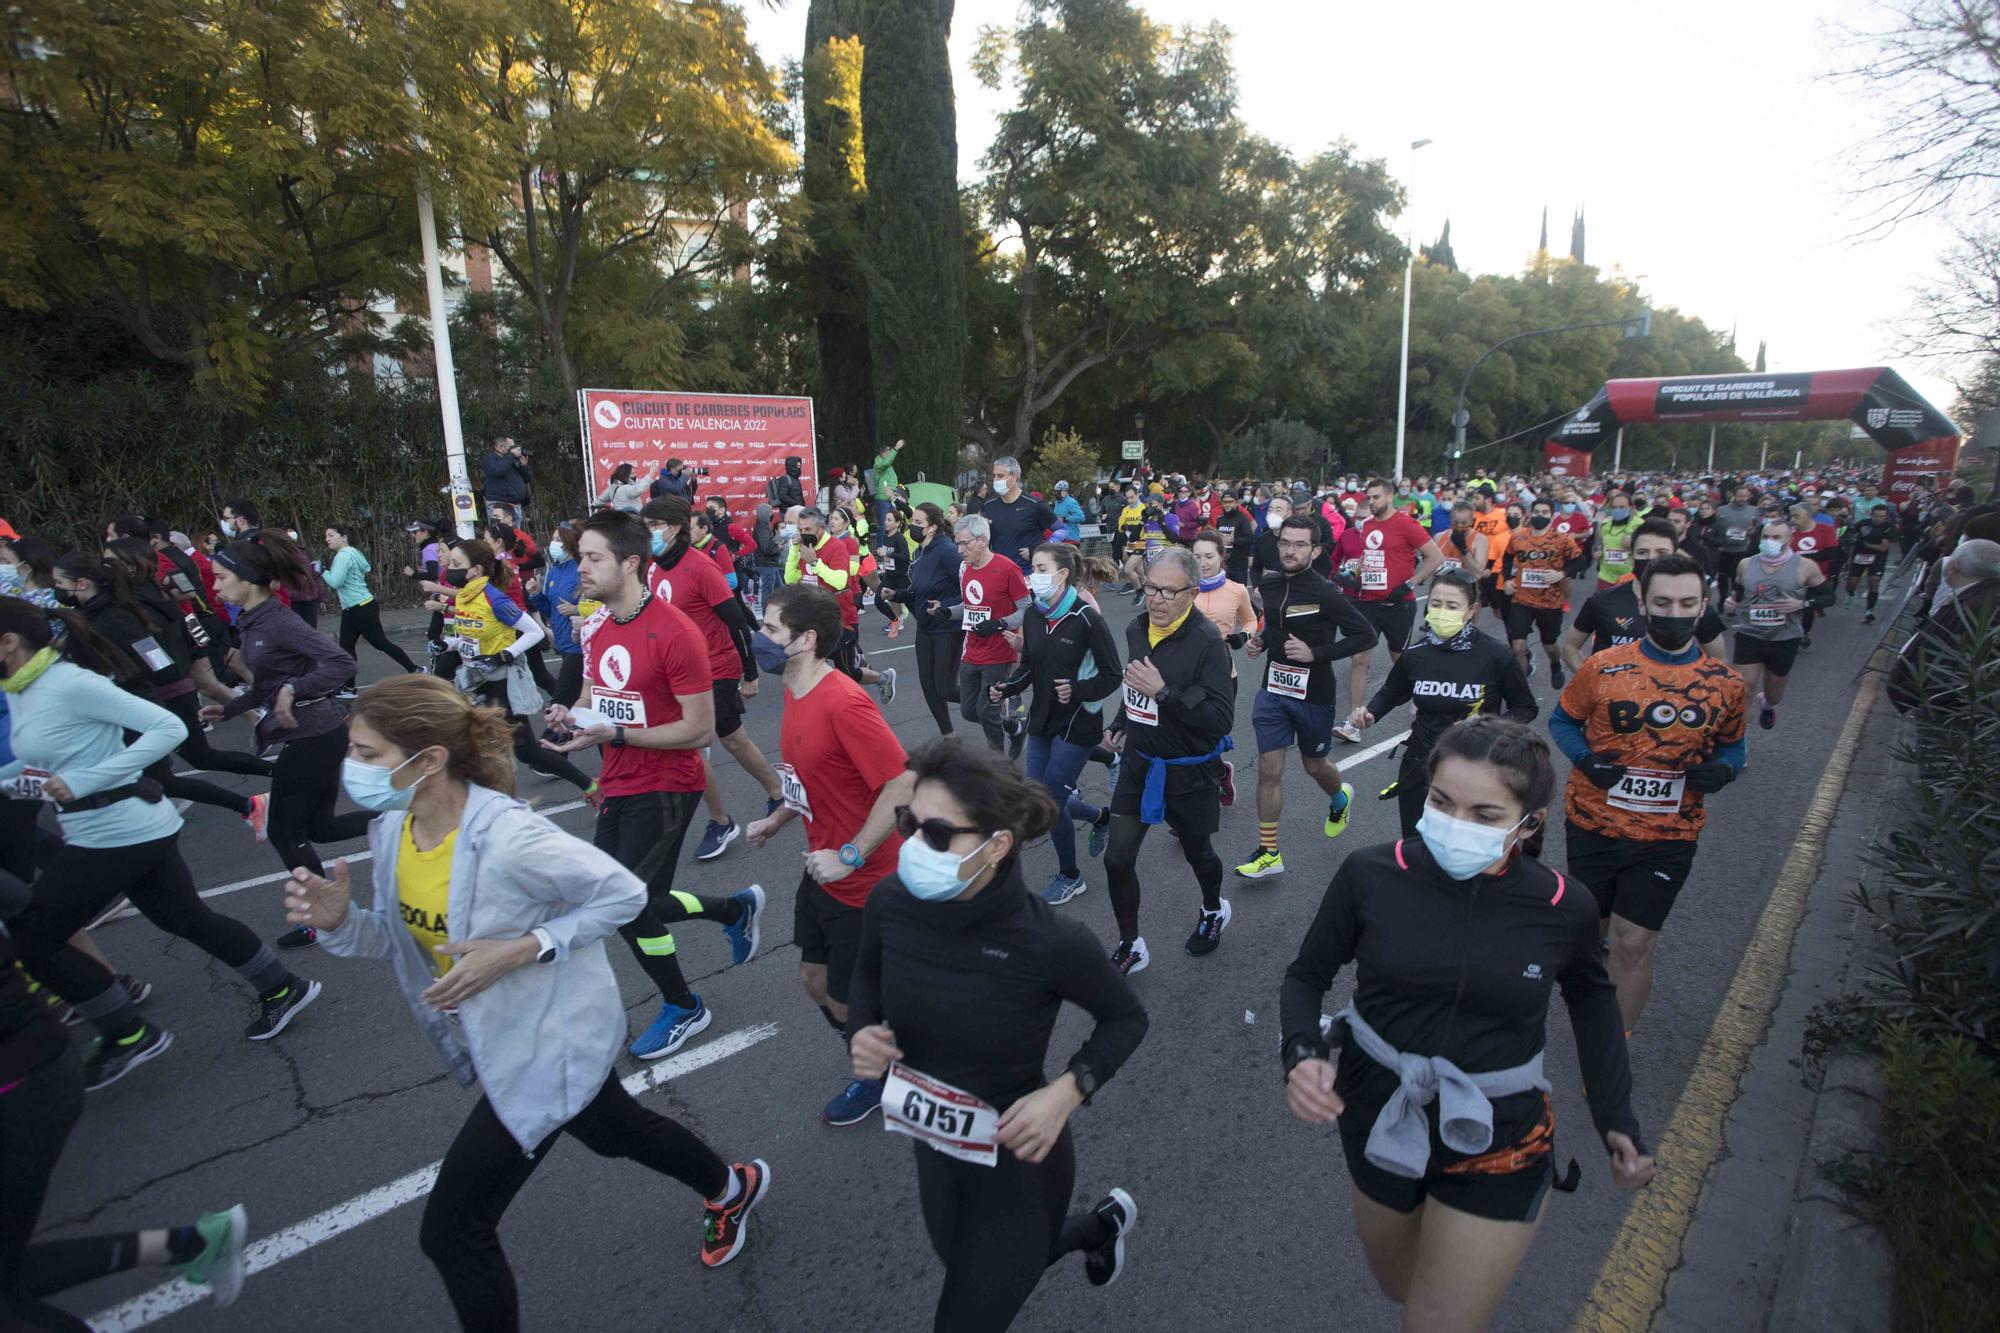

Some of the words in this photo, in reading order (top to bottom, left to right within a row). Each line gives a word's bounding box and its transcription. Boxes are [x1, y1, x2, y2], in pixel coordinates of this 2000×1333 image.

[1661, 384, 1701, 394] CIRCUIT
[1702, 383, 1716, 392] DE
[1717, 381, 1776, 391] CARRERES
[1673, 392, 1728, 402] POPULARS
[1729, 391, 1744, 400] DE
[622, 401, 672, 416] CIRCUIT
[675, 403, 690, 416] DE
[693, 404, 750, 418] CARRERES
[753, 405, 806, 419] POPULARS
[624, 417, 665, 429] CIUTAT
[668, 419, 685, 430] DE
[744, 420, 768, 431] 2022
[1364, 573, 1382, 582] 5831
[967, 611, 986, 623] 4735
[1273, 670, 1301, 688] 5502
[1127, 687, 1150, 710] 4527
[1413, 680, 1481, 699] REDOLAT
[599, 698, 635, 721] 6865
[1608, 700, 1721, 735] BOO!
[1620, 777, 1673, 798] 4334
[903, 1089, 976, 1139] 6757
